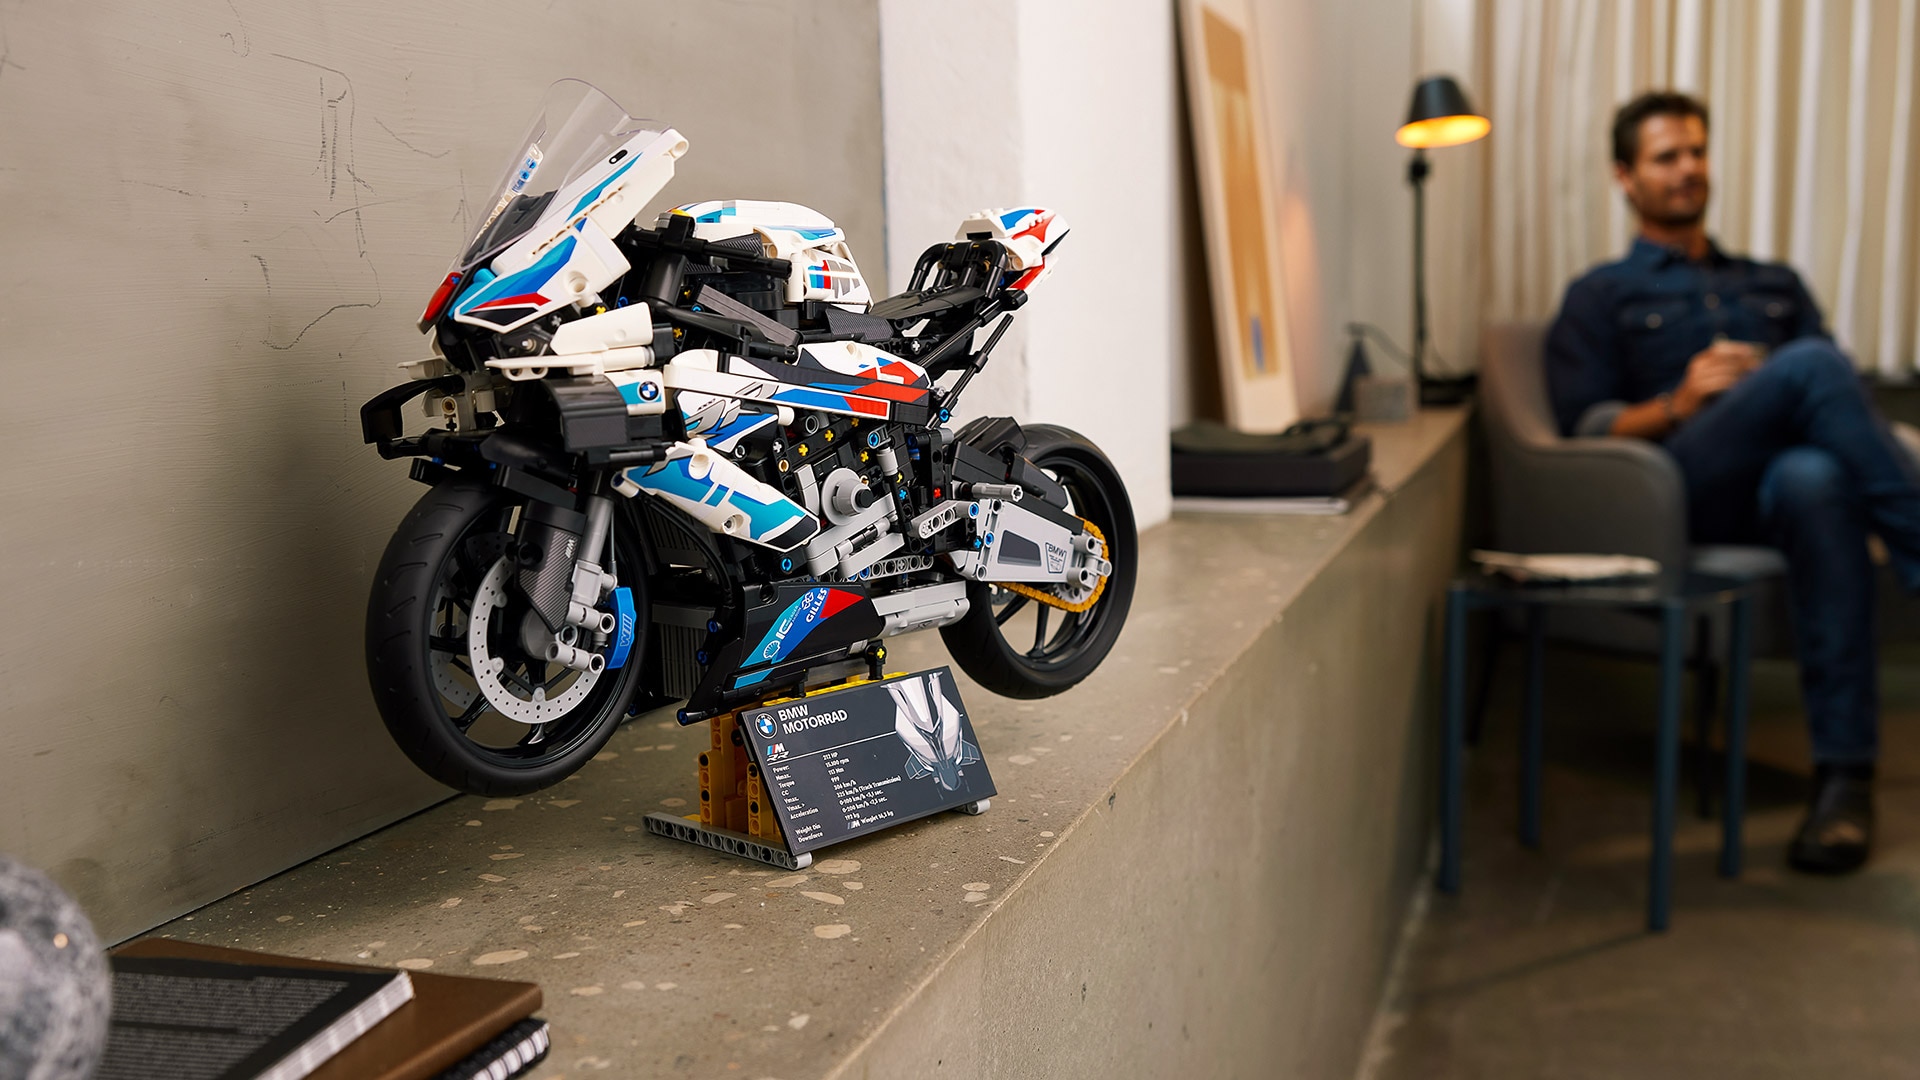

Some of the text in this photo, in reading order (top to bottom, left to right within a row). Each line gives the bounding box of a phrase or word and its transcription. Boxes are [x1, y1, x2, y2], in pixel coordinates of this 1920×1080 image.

[1048, 544, 1065, 557] BMW
[806, 588, 827, 622] GILLES
[778, 704, 808, 721] BMW
[782, 710, 848, 734] MOTORRAD
[845, 787, 859, 795] km/h
[859, 783, 872, 792] (Track
[872, 775, 901, 787] Transmission)
[791, 808, 818, 820] Acceleration
[795, 826, 812, 835] Weight
[798, 832, 823, 842] Downforce
[860, 815, 878, 824] Winglet
